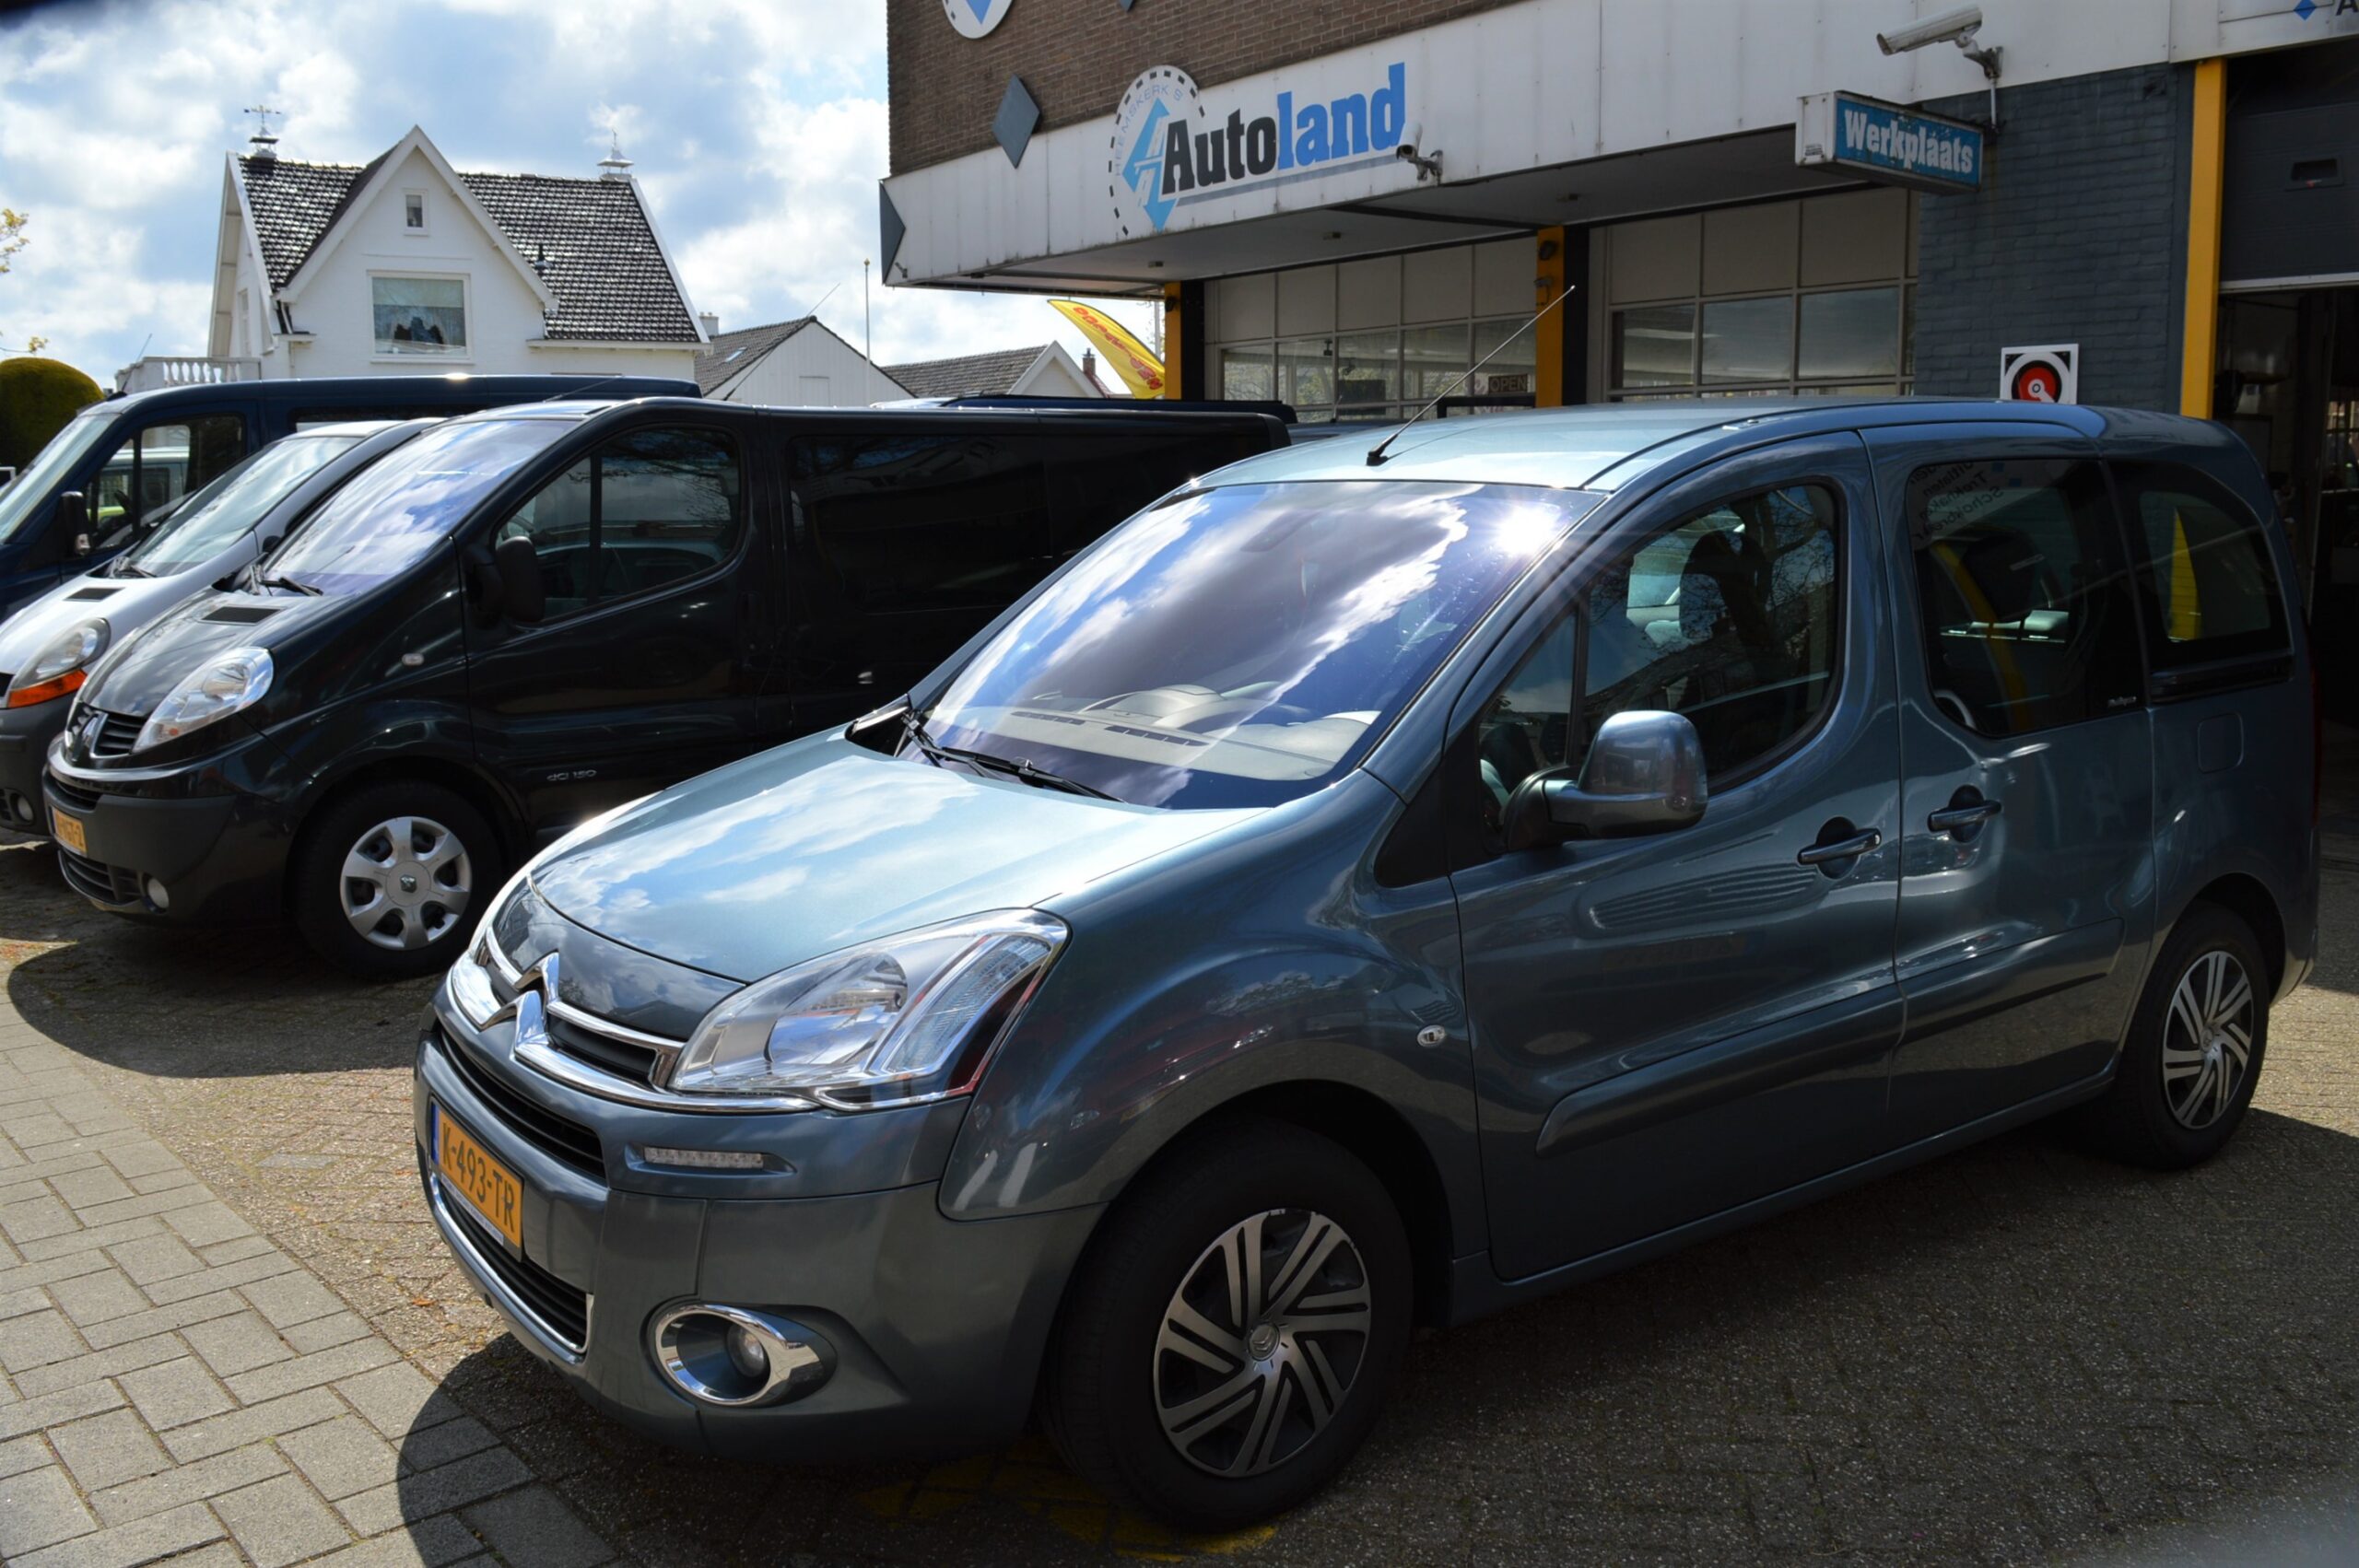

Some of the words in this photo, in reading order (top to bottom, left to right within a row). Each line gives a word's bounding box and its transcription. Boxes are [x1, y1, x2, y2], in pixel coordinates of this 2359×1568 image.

[1162, 63, 1405, 194] Autoland
[1845, 110, 1974, 174] Werkplaats
[1489, 375, 1527, 392] OPEN
[442, 1122, 515, 1234] K-493-TR
